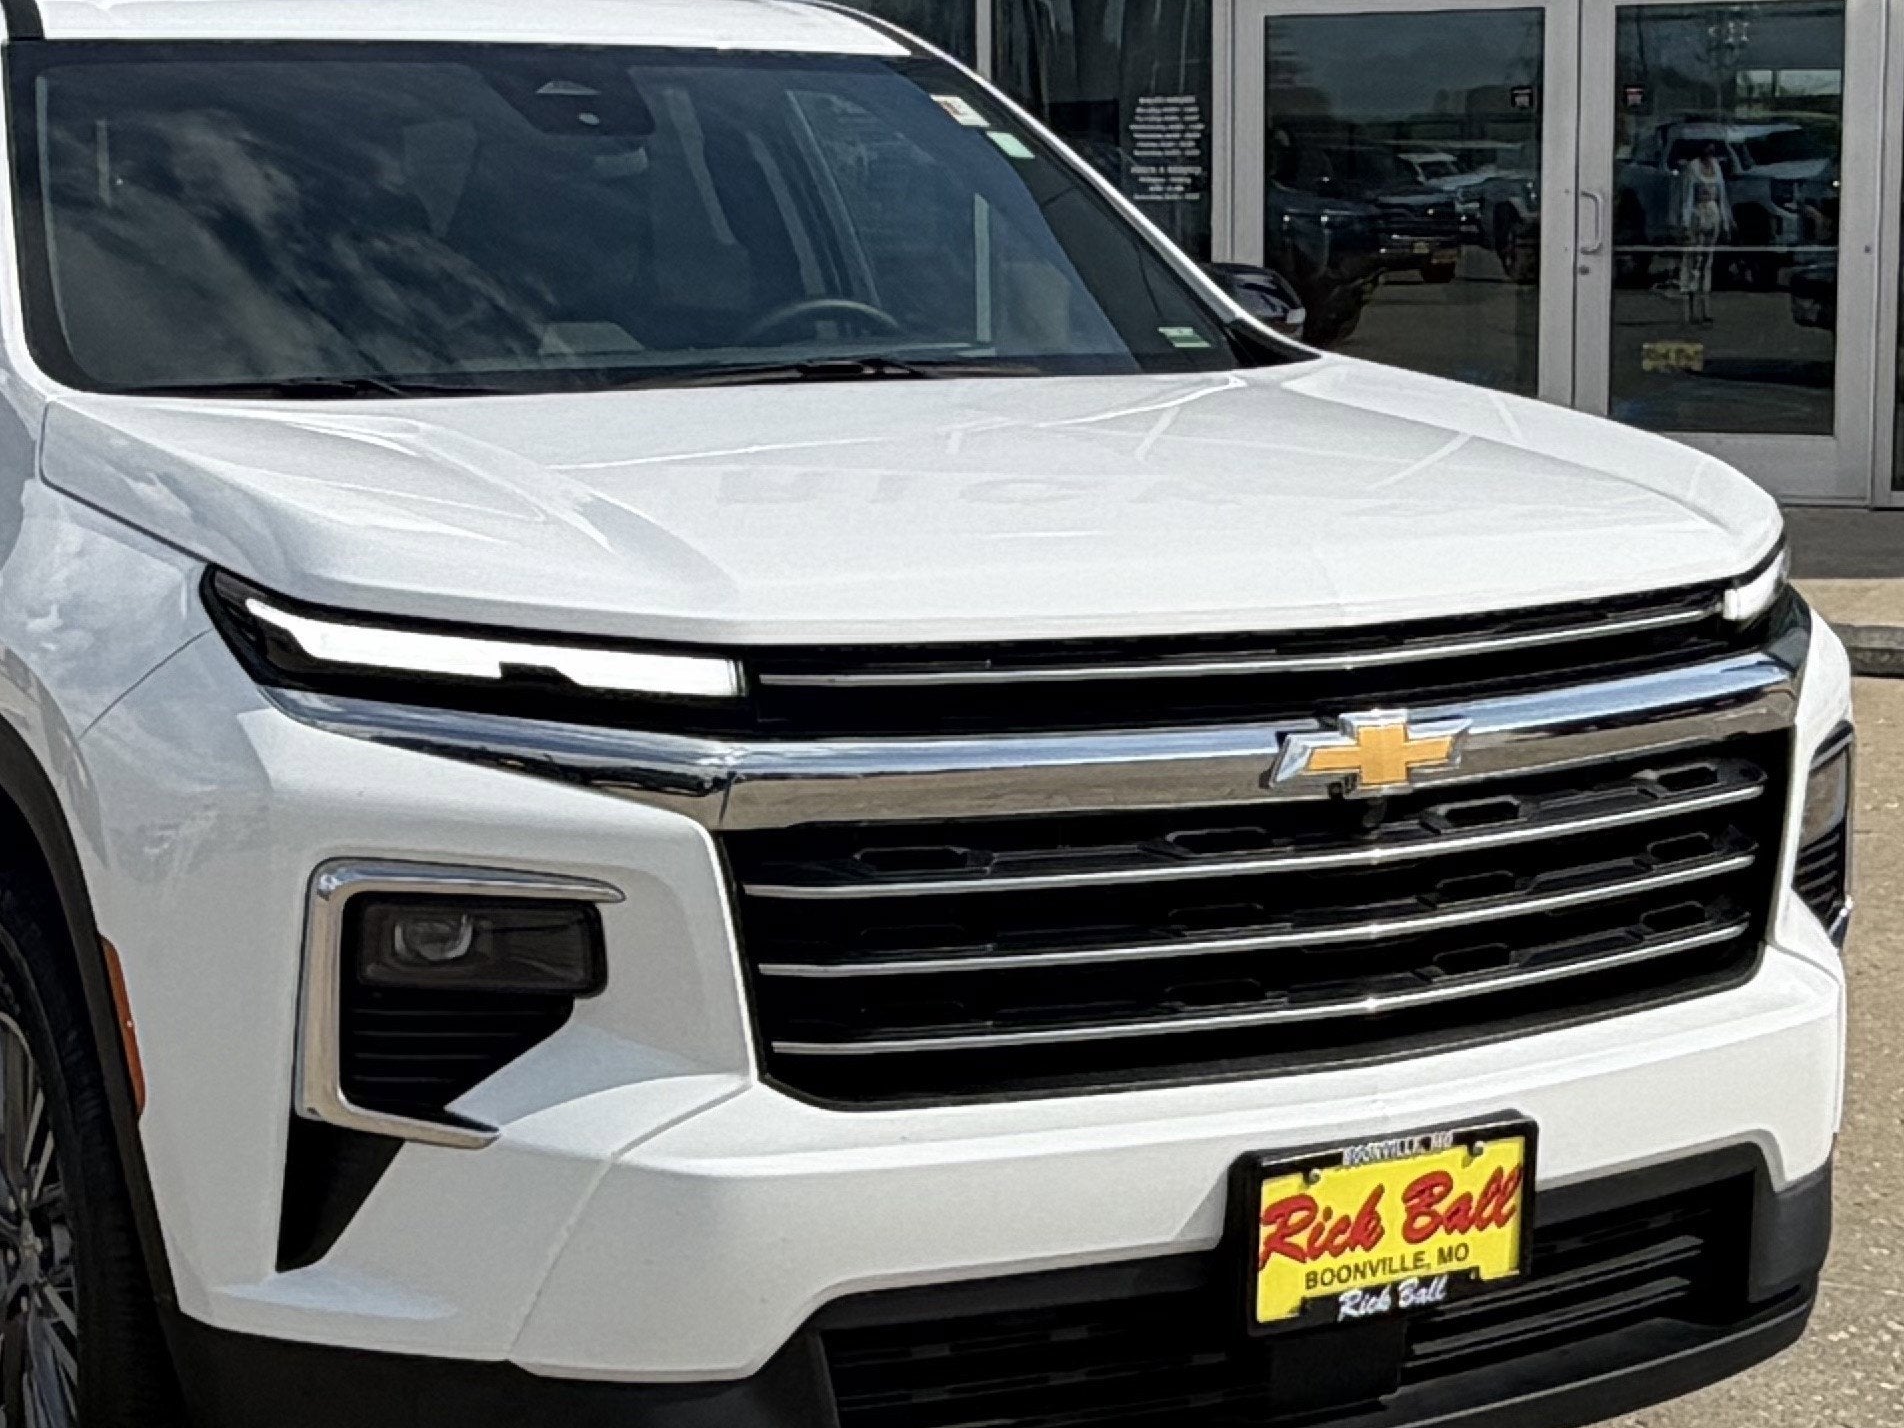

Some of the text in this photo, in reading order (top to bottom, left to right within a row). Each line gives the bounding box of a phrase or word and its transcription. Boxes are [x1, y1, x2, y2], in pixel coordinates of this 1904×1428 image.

[1260, 1163, 1523, 1271] Rick Ball
[1304, 1242, 1470, 1290] BOONVILLE, MO
[1338, 1276, 1447, 1321] Rick Ball
